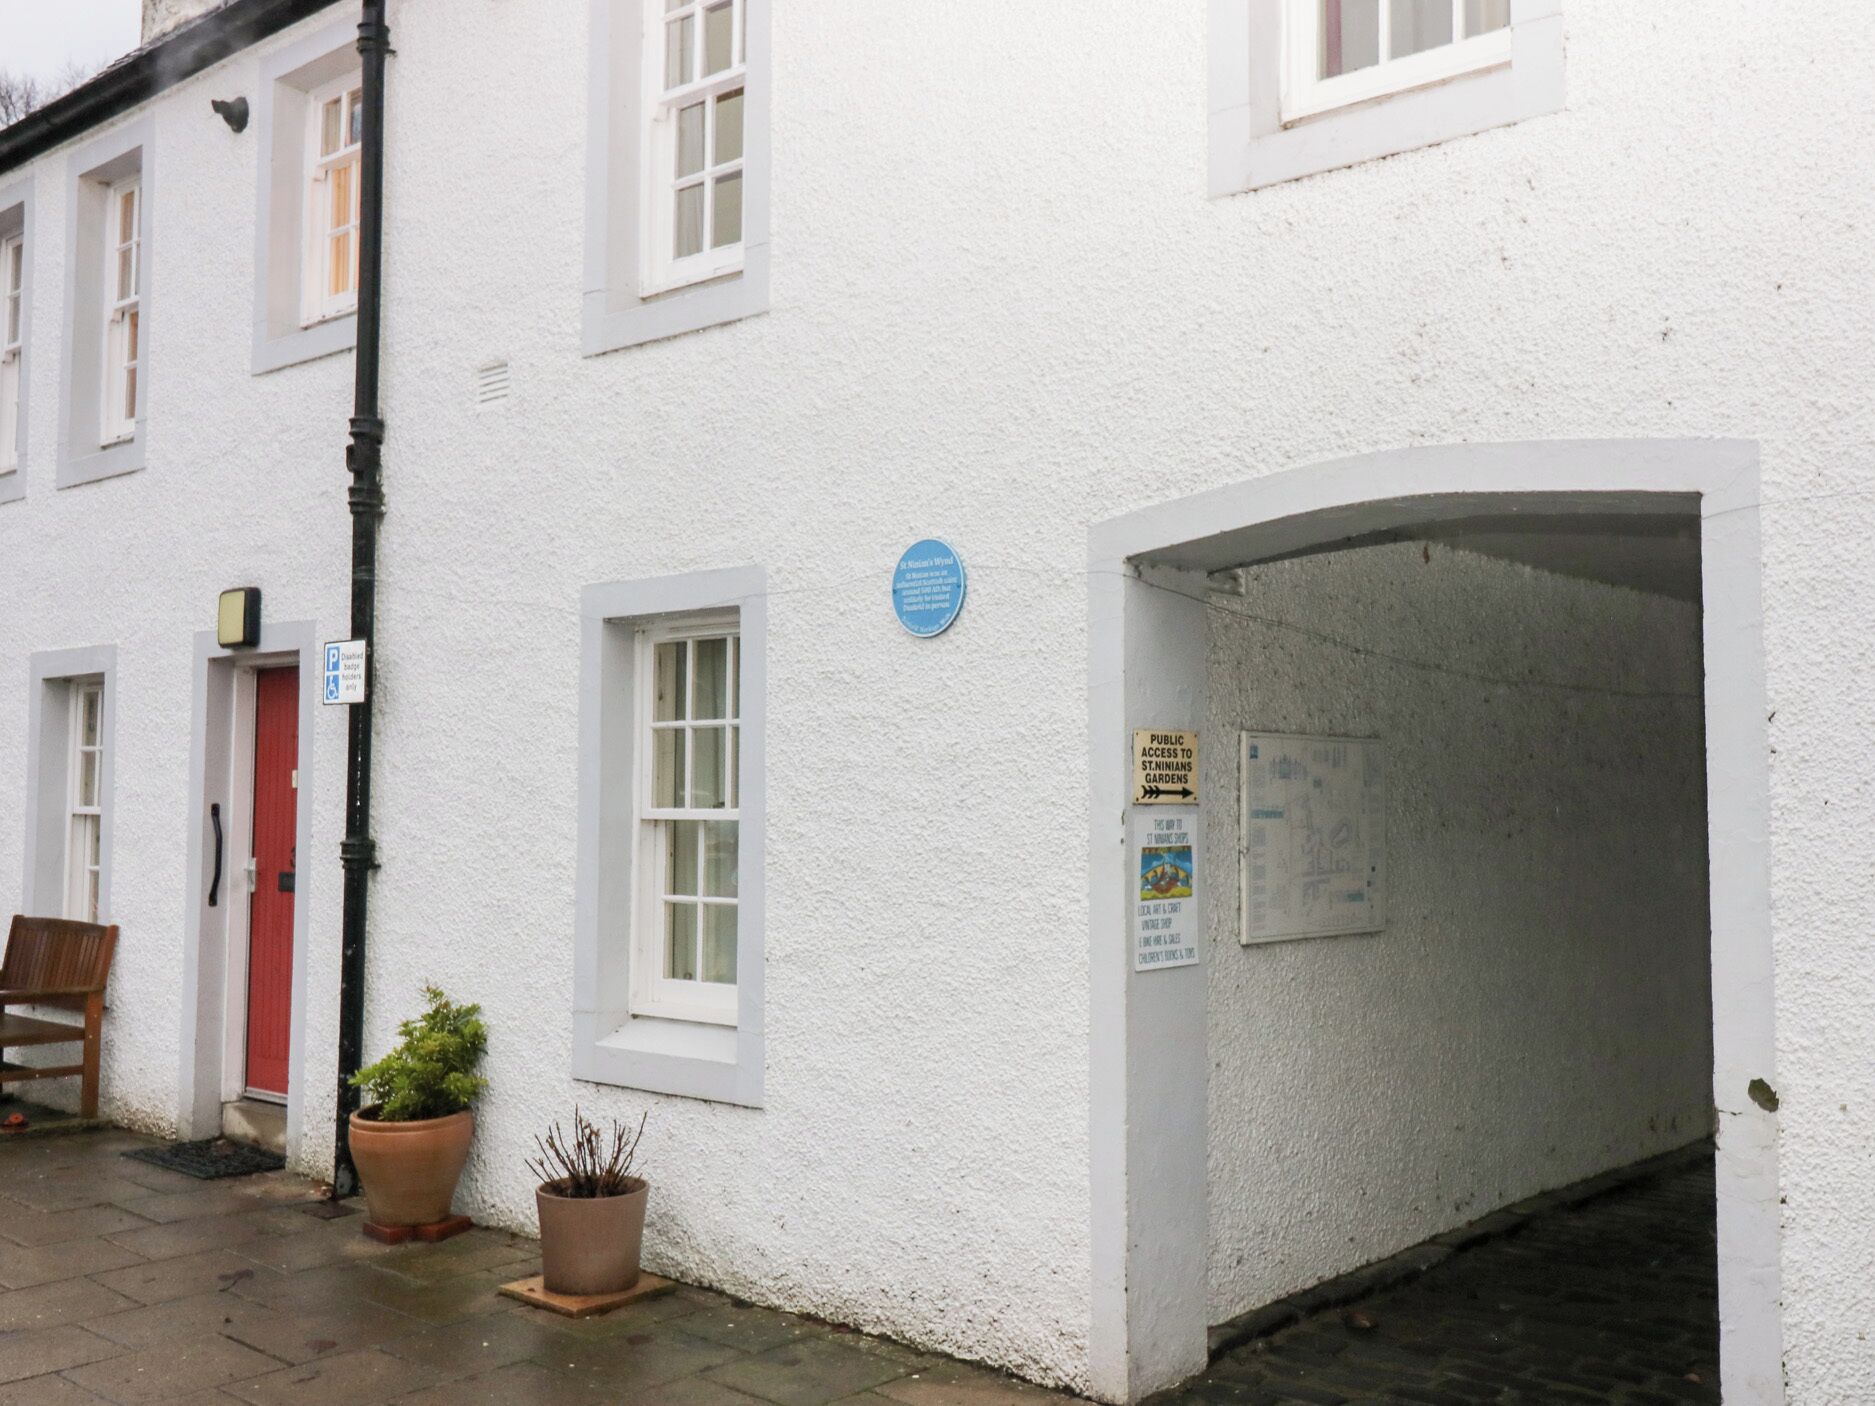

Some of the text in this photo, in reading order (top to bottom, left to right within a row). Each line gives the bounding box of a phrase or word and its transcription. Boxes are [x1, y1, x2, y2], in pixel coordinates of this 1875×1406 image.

[908, 558, 933, 568] Ninian's
[934, 556, 953, 567] Wynd
[329, 649, 338, 671] P
[342, 652, 363, 660] Disabled
[344, 663, 359, 671] badge
[342, 672, 361, 680] holders
[346, 684, 357, 692] only
[1150, 734, 1184, 745] PUBLIC
[1141, 747, 1192, 759] ACCESS TO
[1142, 760, 1192, 772] ST.NINIANS
[1145, 773, 1188, 784] GARDENS
[1154, 819, 1183, 831] THIS WAY TO
[1138, 904, 1151, 917] LOCAL
[1153, 903, 1161, 915] ART
[1168, 902, 1181, 914] CRAFT
[1142, 917, 1172, 931] VINTAGE SHOP
[1143, 936, 1152, 947] BIKE
[1153, 934, 1162, 946] HIRE
[1168, 932, 1181, 944] SALES
[1139, 951, 1163, 965] CHILDREN'S
[1165, 949, 1179, 961] BOOKS
[1185, 947, 1195, 959] TOYS
